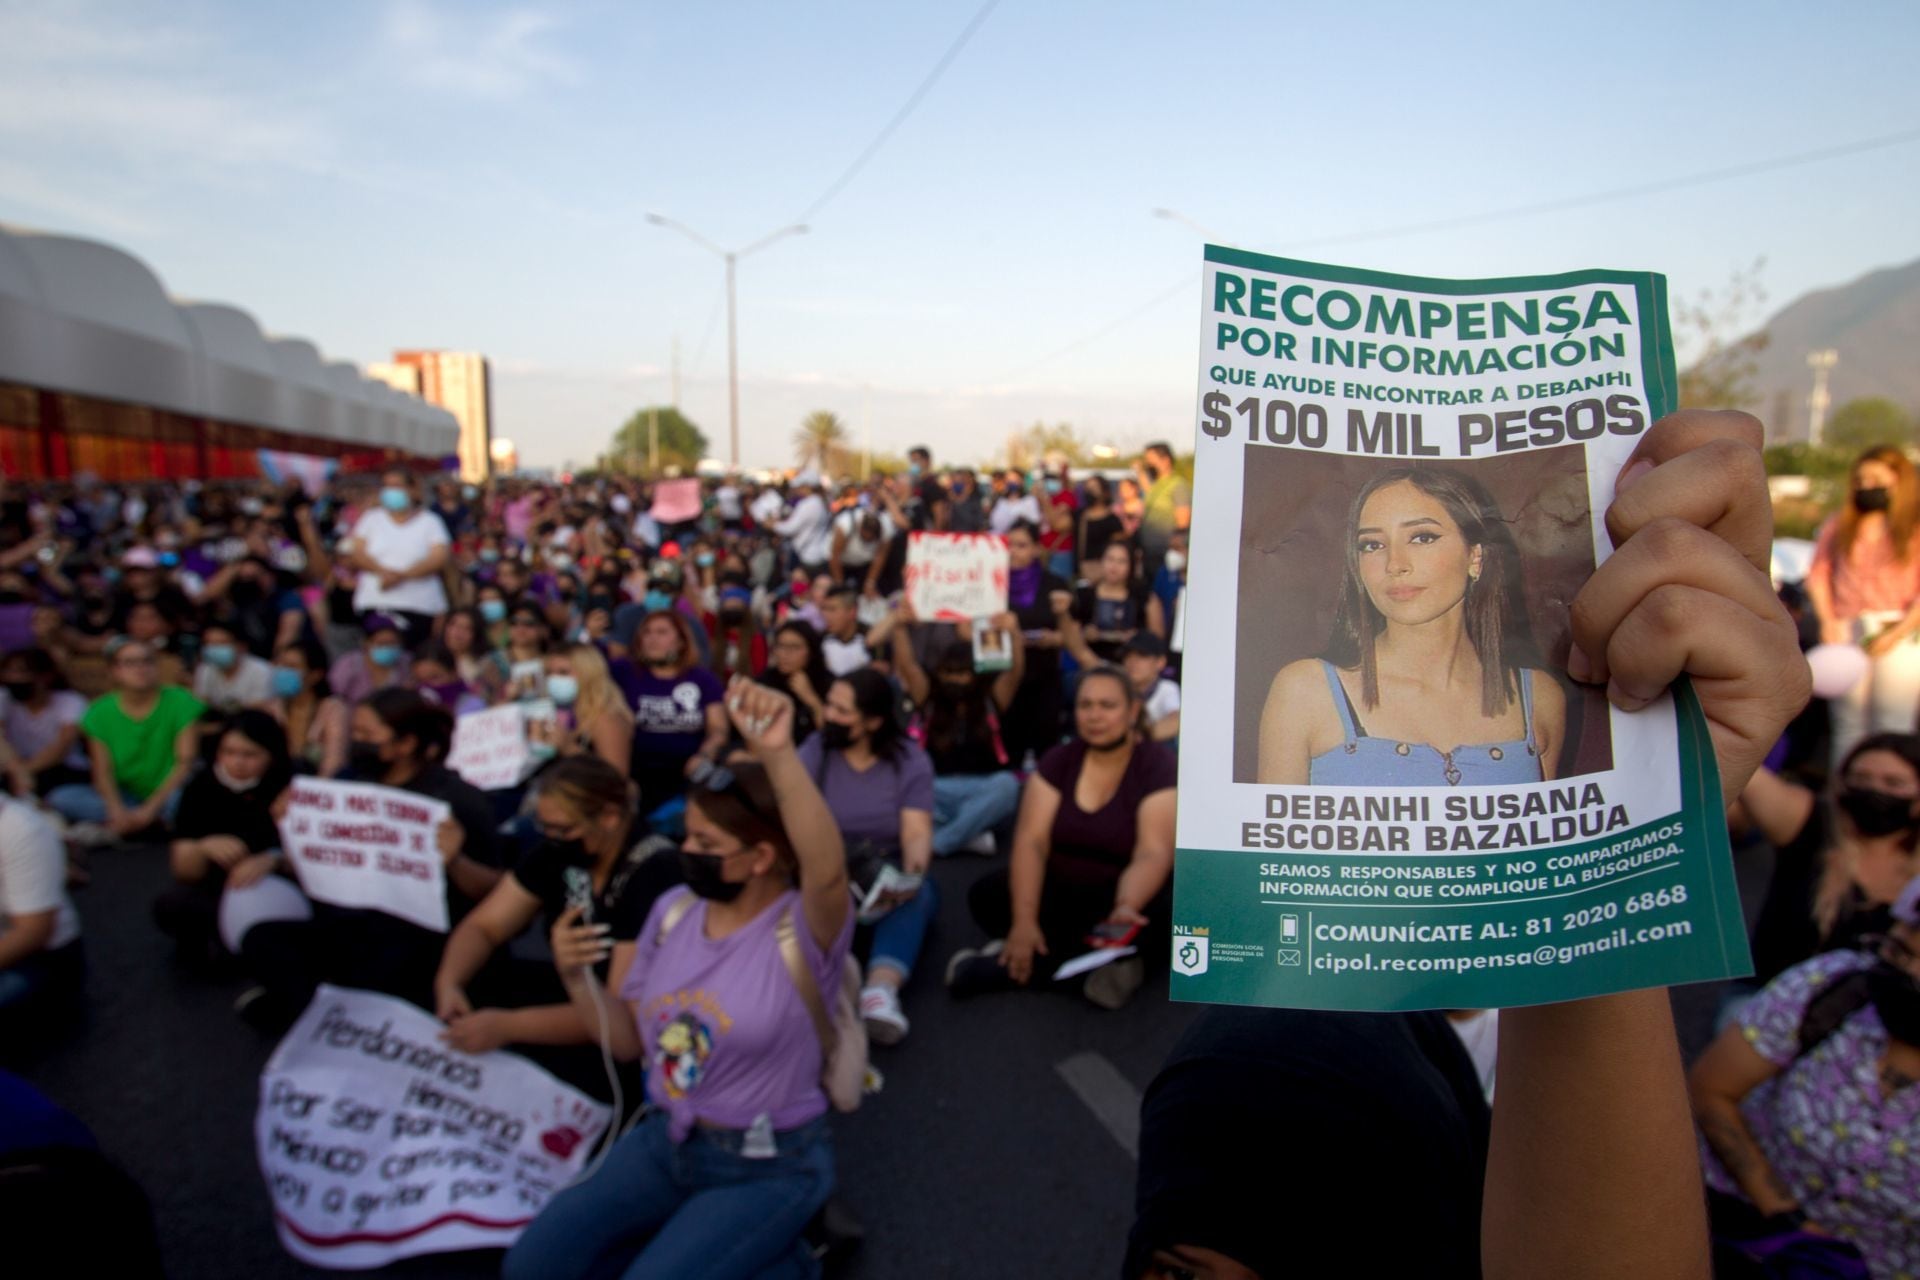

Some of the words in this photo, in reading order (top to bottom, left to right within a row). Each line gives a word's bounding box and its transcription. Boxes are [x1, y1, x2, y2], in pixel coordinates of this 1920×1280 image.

[1214, 271, 1632, 340] RECOMPENSA
[1217, 322, 1297, 361] POR
[1312, 332, 1625, 376] INFORMACIÓN
[1210, 365, 1256, 387] QUE
[1263, 373, 1335, 397] AYUDE
[1343, 382, 1483, 405] ENCONTRAR
[1491, 386, 1509, 402] A
[1517, 370, 1632, 400] DEBANHI
[1201, 389, 1328, 448] $100
[1347, 408, 1440, 457] MIL
[1458, 394, 1644, 456] PESOS
[1241, 822, 1410, 851] ESCOBAR
[1425, 804, 1630, 851] BAZALDUA
[1265, 794, 1429, 821] DEBANHI
[1445, 782, 1605, 821] SUSANA
[1259, 863, 1331, 878] SEAMOS
[1340, 865, 1476, 879] RESPONSABLES
[1485, 864, 1497, 877] Y
[1506, 861, 1537, 875] NO
[1546, 822, 1684, 870] COMPARTAMOS
[1259, 881, 1388, 897] INFORMACIÓN
[1394, 884, 1433, 899] QUE
[1439, 877, 1548, 898] COMPLIQUE
[1554, 873, 1577, 887] LA
[1581, 842, 1685, 883] BÚSQUEDA.
[1173, 925, 1193, 936] NL
[1314, 921, 1473, 943] COMUNÍCATE
[1480, 921, 1518, 940] AL:
[1525, 916, 1552, 936] 81
[1562, 901, 1618, 931] 2020
[1625, 884, 1688, 914] 6868
[1314, 919, 1692, 975] cipol.recompensa@gmail.com
